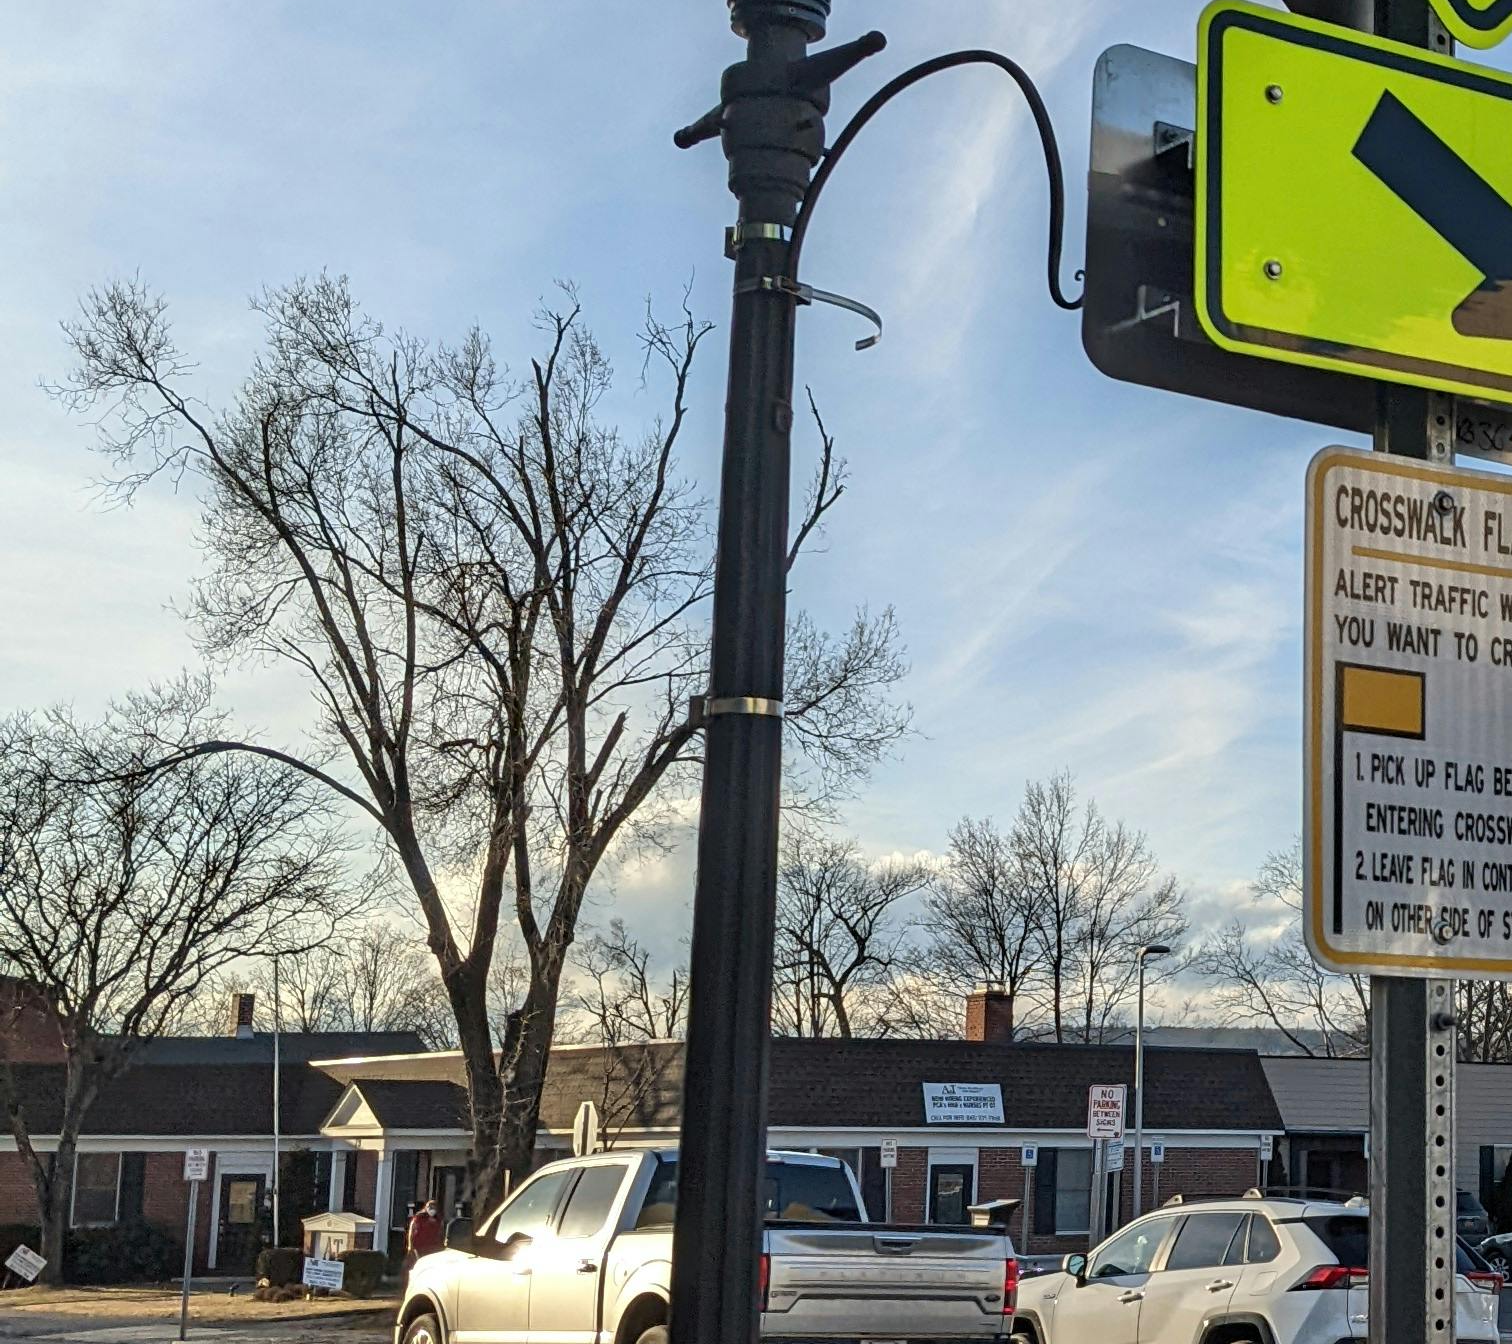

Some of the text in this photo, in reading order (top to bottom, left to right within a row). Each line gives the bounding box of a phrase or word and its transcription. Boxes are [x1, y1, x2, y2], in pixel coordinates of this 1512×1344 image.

[1335, 484, 1467, 548] CROSSWALK
[1334, 568, 1399, 605] ALERT
[1409, 579, 1489, 619] TRAFFIC
[1334, 614, 1375, 648] YOU
[1387, 621, 1442, 657] WANT
[1454, 631, 1478, 662] TO
[1356, 751, 1365, 781] 1.
[1371, 753, 1405, 786] PICK
[1415, 759, 1436, 789] UP
[1444, 761, 1485, 794] FLAG
[1366, 802, 1443, 839] ENTERING
[1355, 850, 1368, 881] 2.
[1372, 851, 1414, 884] LEAVE
[1420, 856, 1455, 888] FLAG
[1462, 860, 1475, 889] IN
[1365, 900, 1384, 931] ON
[1391, 901, 1433, 934] OTHER
[1478, 908, 1495, 940] OF
[1093, 1100, 1120, 1109] PARKING
[1101, 1089, 1114, 1099] NO
